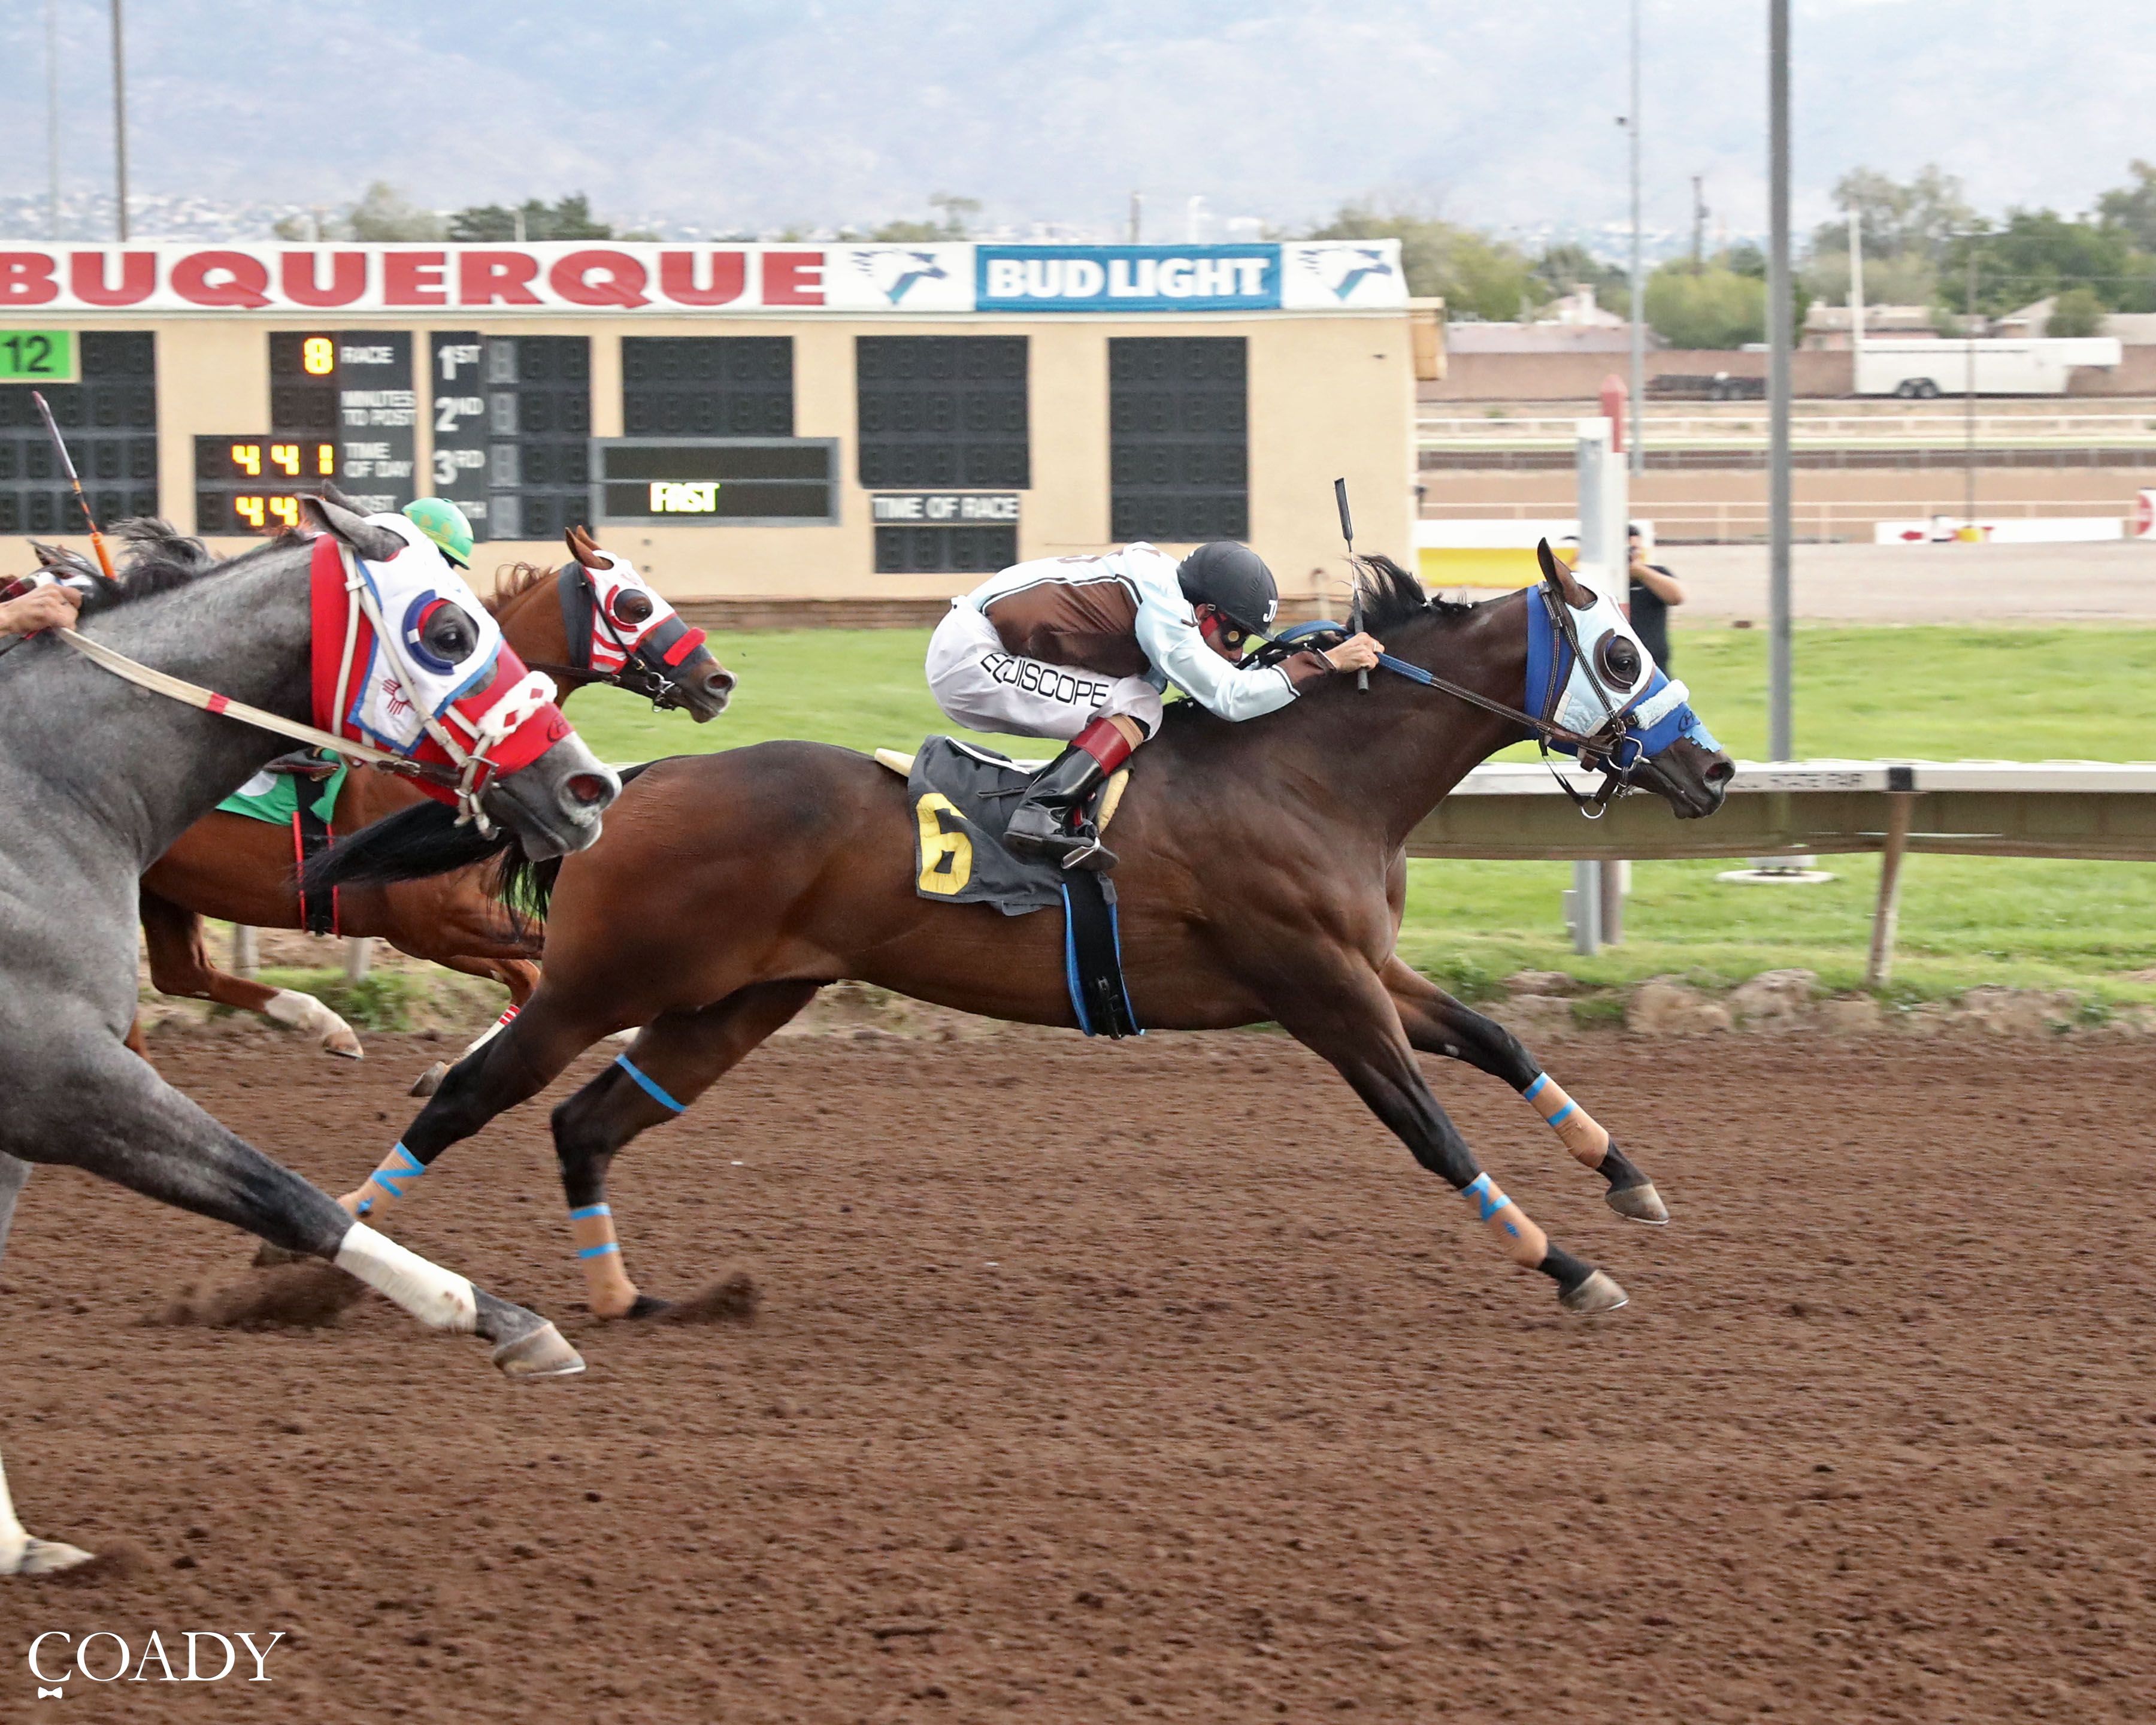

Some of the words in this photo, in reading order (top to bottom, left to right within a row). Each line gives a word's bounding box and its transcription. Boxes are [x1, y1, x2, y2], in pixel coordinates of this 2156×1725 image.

[0, 250, 826, 309] BUQUERQUE
[986, 259, 1106, 298] BUD
[1108, 258, 1271, 298] LIGHT
[3, 335, 54, 373] 12
[303, 337, 334, 375] 8
[340, 346, 395, 364] RACE
[340, 390, 416, 407] MINUTES
[341, 408, 370, 426] TO
[370, 408, 417, 426] POST
[343, 442, 390, 459] TIME
[343, 461, 374, 478] OF
[374, 461, 414, 478] DAY
[650, 482, 722, 513] FAST
[871, 497, 924, 519] TIME
[925, 497, 959, 519] OF
[960, 497, 1020, 519] RACE
[915, 792, 973, 896] 6
